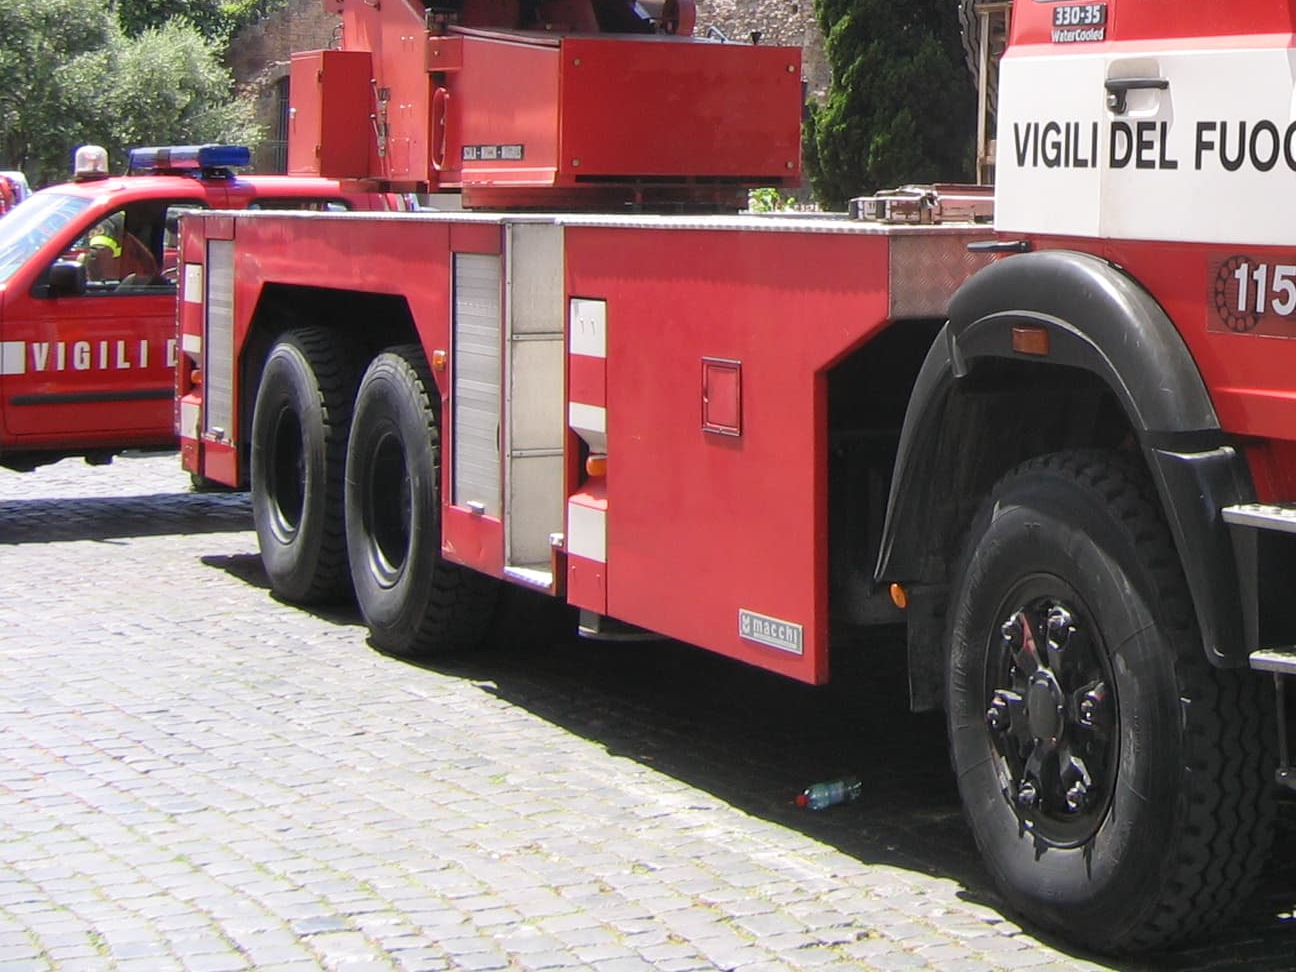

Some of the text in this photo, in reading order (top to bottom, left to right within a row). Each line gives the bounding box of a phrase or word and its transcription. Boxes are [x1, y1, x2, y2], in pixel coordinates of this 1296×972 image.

[1013, 121, 1098, 168] VIGILI
[1109, 121, 1179, 170] DEL
[32, 339, 149, 372] VIGILI
